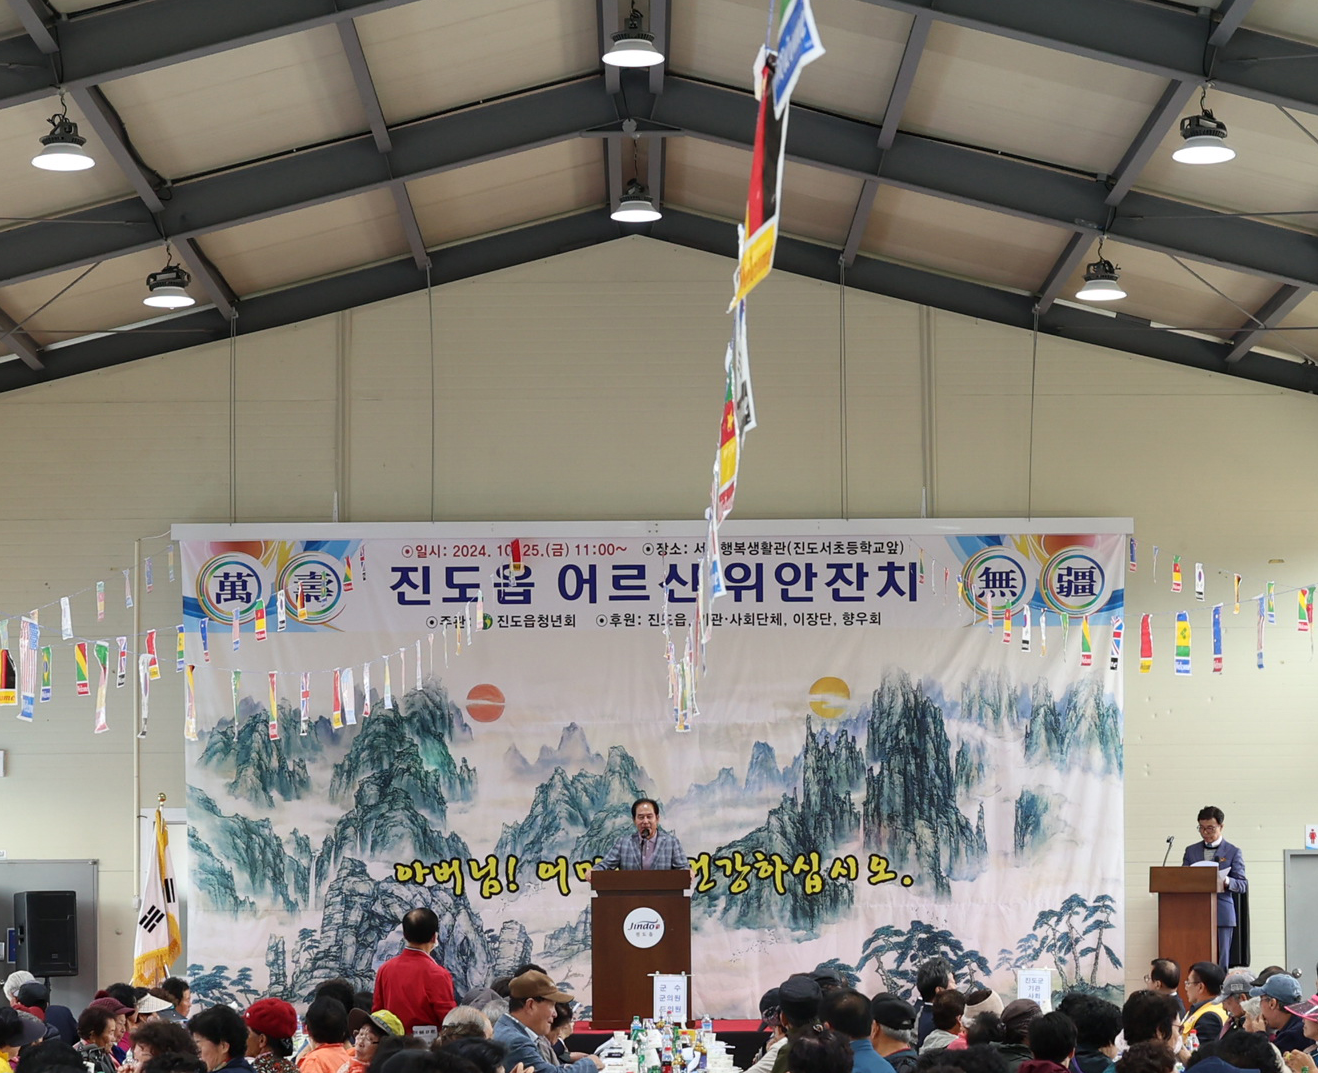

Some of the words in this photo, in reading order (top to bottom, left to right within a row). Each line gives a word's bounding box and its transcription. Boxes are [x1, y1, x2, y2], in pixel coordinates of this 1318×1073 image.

[415, 544, 448, 558] 일시:
[453, 545, 491, 558] 2024.
[575, 544, 628, 557] 11:00~
[657, 542, 688, 556] 장소:
[694, 541, 904, 556] 서행복생활관(진도서초등학교앞)
[213, 571, 253, 604] 萬
[293, 571, 334, 604] 壽
[389, 563, 535, 606] 진도읍
[557, 563, 700, 604] 어르신
[723, 561, 918, 603] 위안잔치
[978, 566, 1017, 599] 無
[1056, 566, 1098, 597] 疆
[497, 613, 576, 629] 진도읍청년회
[609, 613, 642, 628] 후원:
[793, 612, 837, 628] 이장단,
[842, 612, 882, 627] 향우회
[394, 854, 520, 898] 아버님!
[687, 850, 914, 896] 건강하십시오.
[627, 922, 655, 931] Jindo
[659, 994, 681, 1002] 군의원
